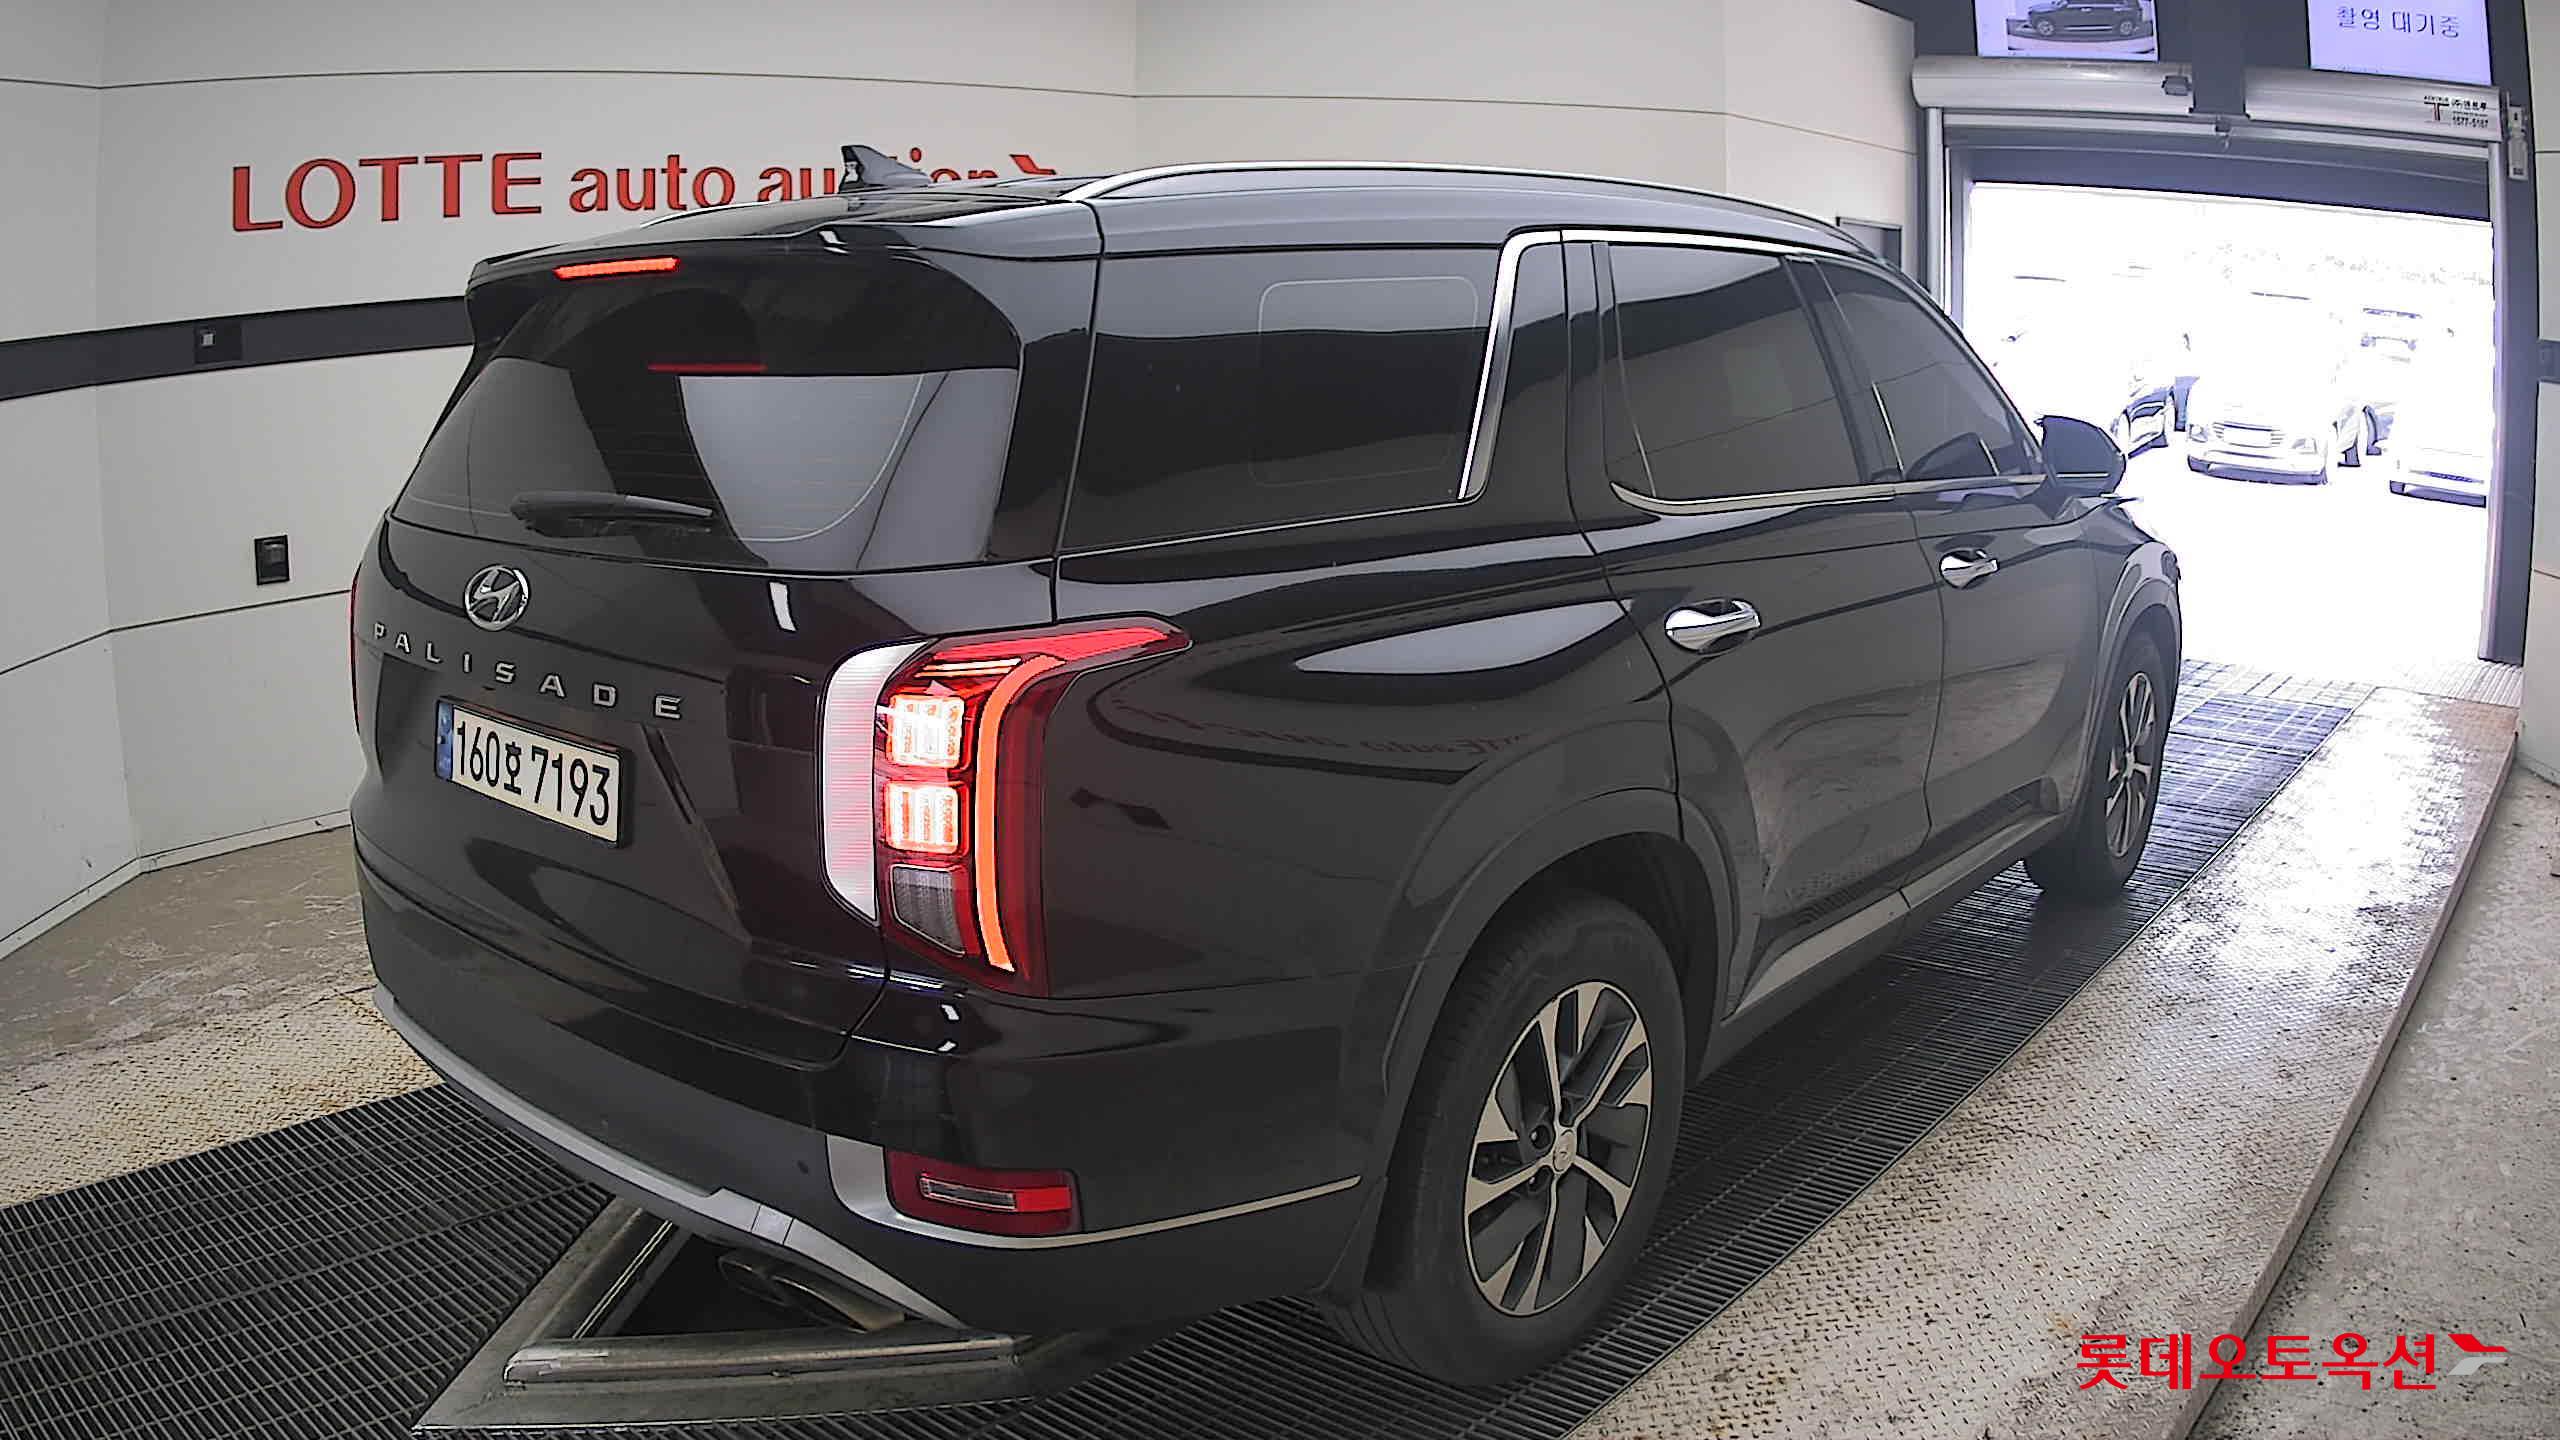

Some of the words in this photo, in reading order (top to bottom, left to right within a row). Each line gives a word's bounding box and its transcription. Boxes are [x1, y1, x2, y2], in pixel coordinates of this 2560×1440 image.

[2337, 6, 2380, 31] 촬영
[2391, 10, 2459, 38] 대기중
[232, 151, 542, 232] LOTTE
[568, 153, 736, 213] auto
[372, 622, 684, 720] PALISADE
